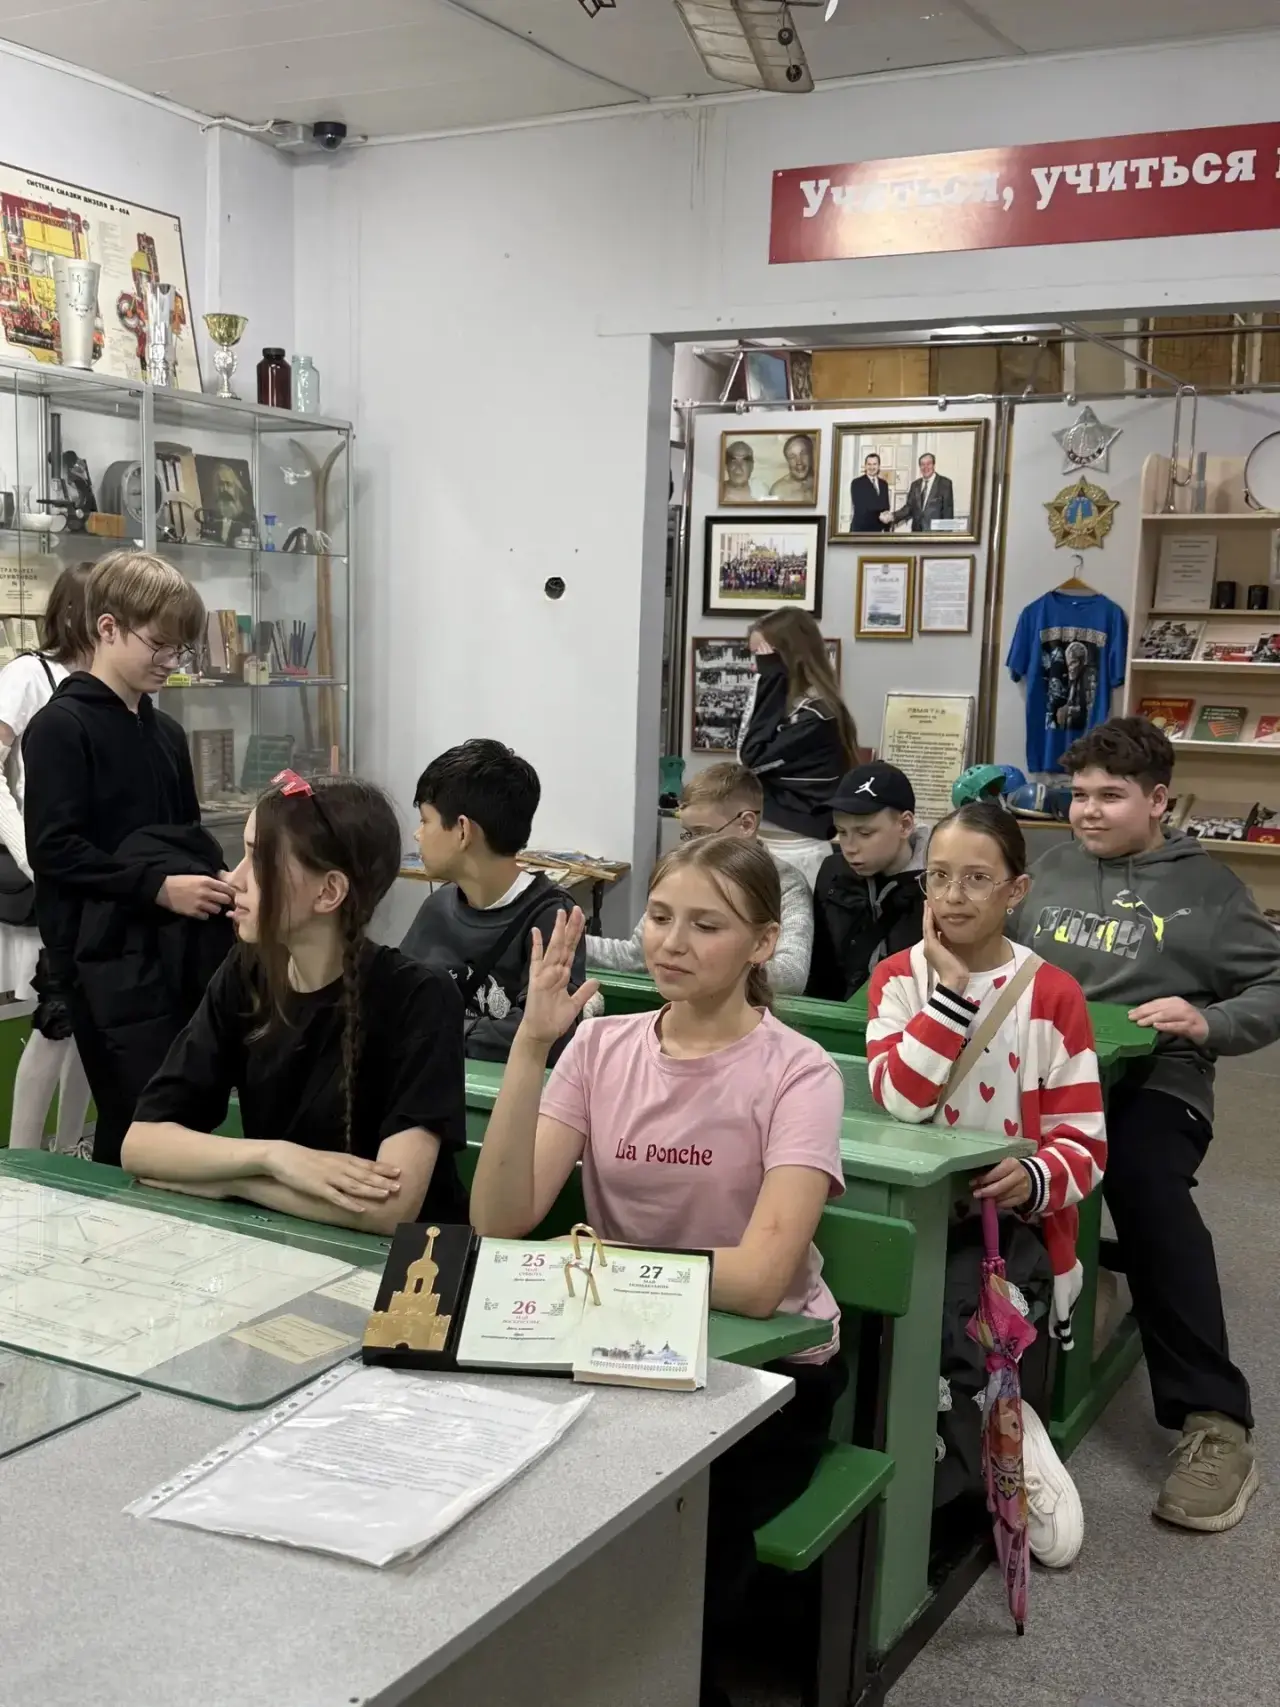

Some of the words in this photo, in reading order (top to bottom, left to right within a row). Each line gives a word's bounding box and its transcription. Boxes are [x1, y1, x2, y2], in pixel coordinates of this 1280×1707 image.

[1031, 148, 1257, 210] учиться
[26, 178, 55, 193] СИСТЕМА
[56, 188, 82, 201] СМАЗКИ
[83, 196, 108, 209] ДИЗЕЛЯ
[1033, 905, 1146, 960] PUMA
[615, 1138, 637, 1160] La
[521, 1253, 546, 1267] 25
[639, 1264, 663, 1279] 27
[511, 1300, 536, 1315] 26
